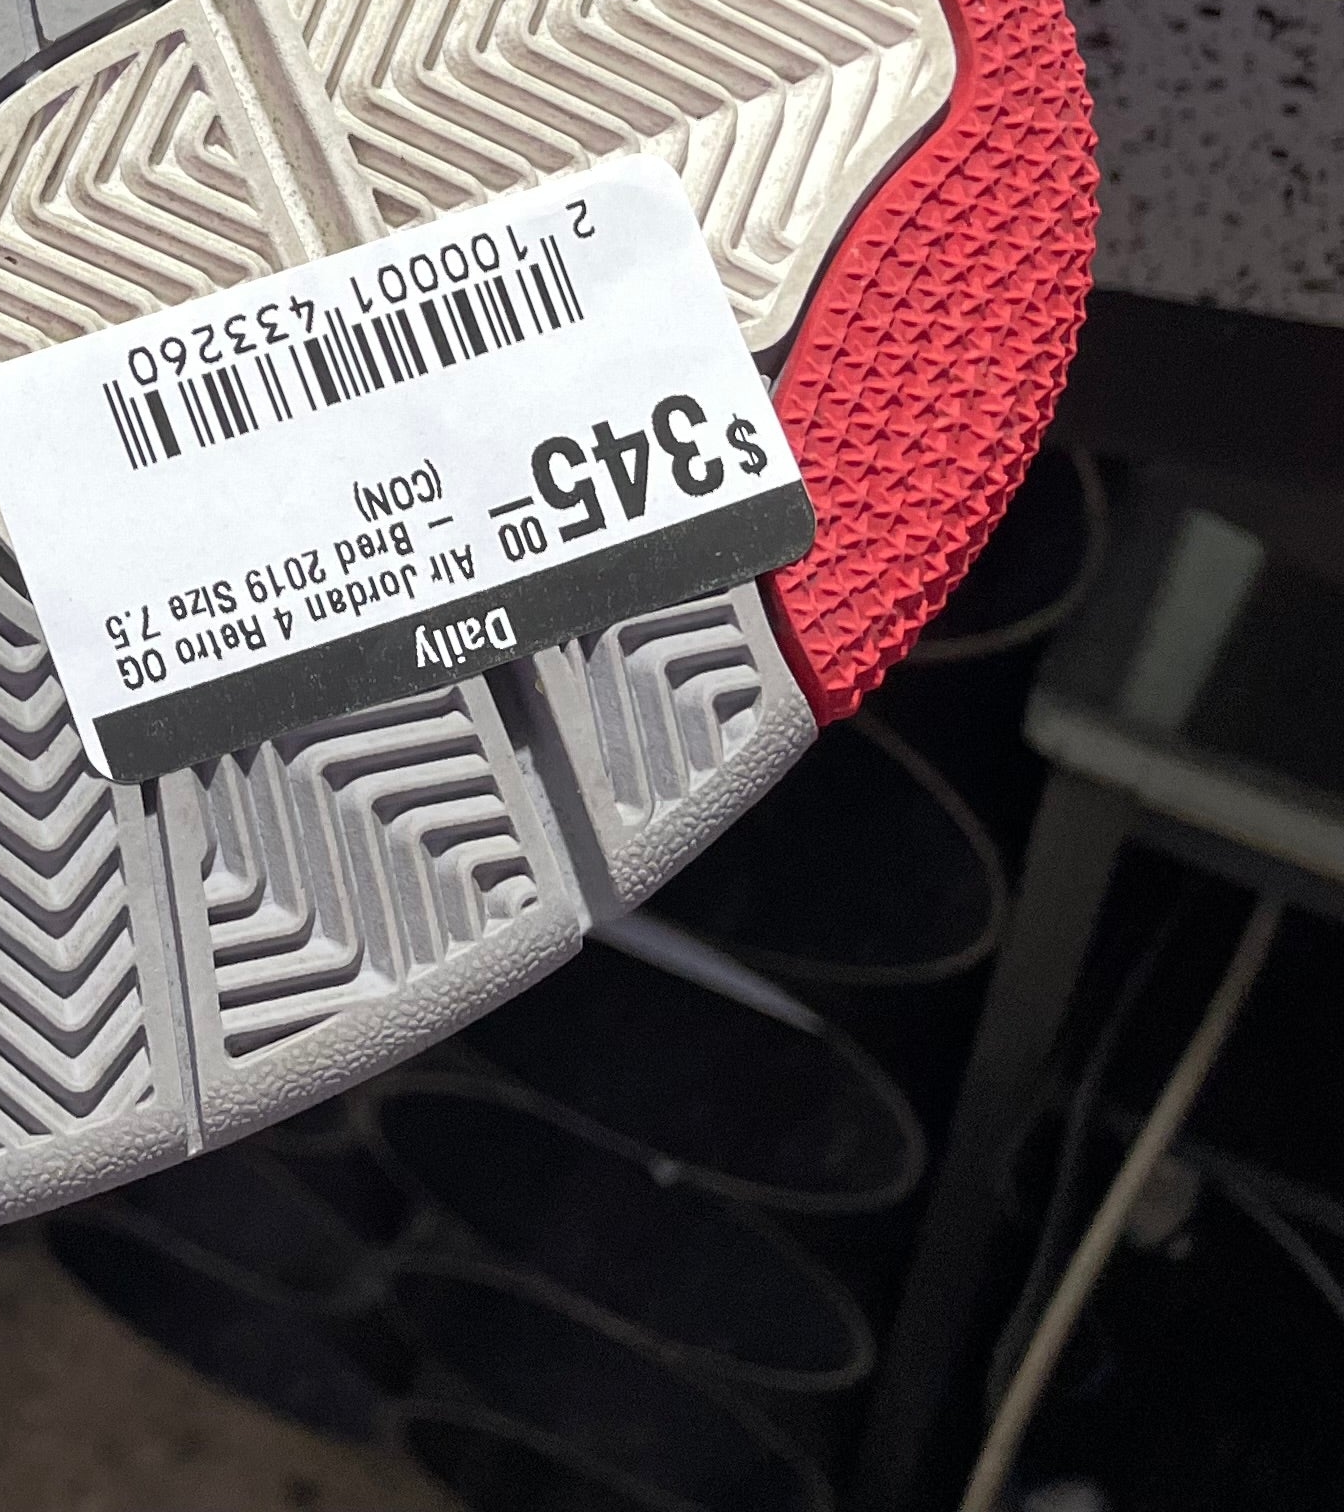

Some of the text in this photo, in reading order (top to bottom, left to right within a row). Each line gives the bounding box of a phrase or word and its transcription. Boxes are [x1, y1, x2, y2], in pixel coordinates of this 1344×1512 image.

[128, 199, 596, 387] 2 100001 433260
[353, 459, 443, 523] (CON)
[245, 549, 328, 604] 2019
[333, 521, 415, 577] Bred
[105, 605, 162, 650] 7.5
[115, 544, 475, 692] Air Jordan 4 Retro OG
[168, 580, 238, 622] Size
[414, 606, 518, 669] Daily
